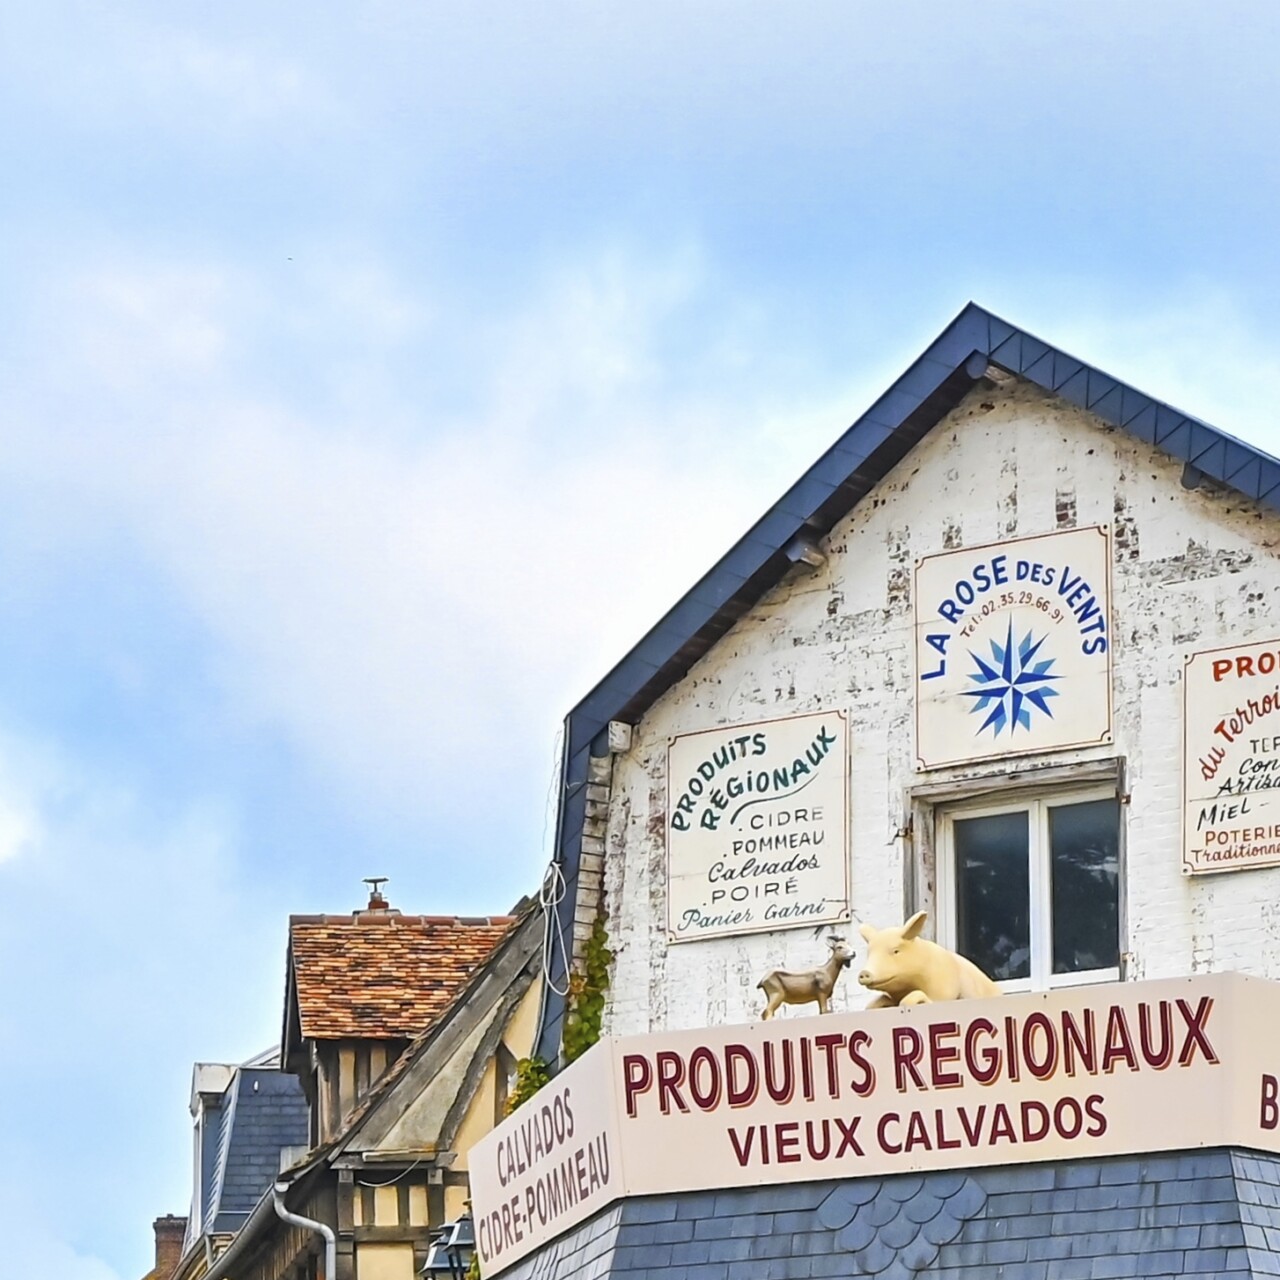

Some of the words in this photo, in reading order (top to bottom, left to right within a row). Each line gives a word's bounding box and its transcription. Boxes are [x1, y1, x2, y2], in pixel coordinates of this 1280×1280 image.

[921, 634, 951, 681] LA
[937, 555, 1008, 624] ROSE
[1016, 560, 1056, 586] DES
[1057, 565, 1108, 655] VENTS
[1198, 747, 1226, 781] du
[750, 807, 824, 830] CIDRE
[733, 830, 825, 856] POMMEAU
[708, 853, 821, 883] Calvados
[712, 876, 799, 905] POIRÉ
[677, 908, 754, 931] Panier
[764, 897, 825, 921] Garni
[623, 1029, 876, 1118] PRODUITS
[892, 995, 1220, 1093] REGIONAUX
[497, 1087, 575, 1188] CALVADOS
[727, 1116, 866, 1167] VIEUX
[876, 1094, 1108, 1155] CALVADOS
[479, 1131, 610, 1263] CIDRE-POMMEAU
